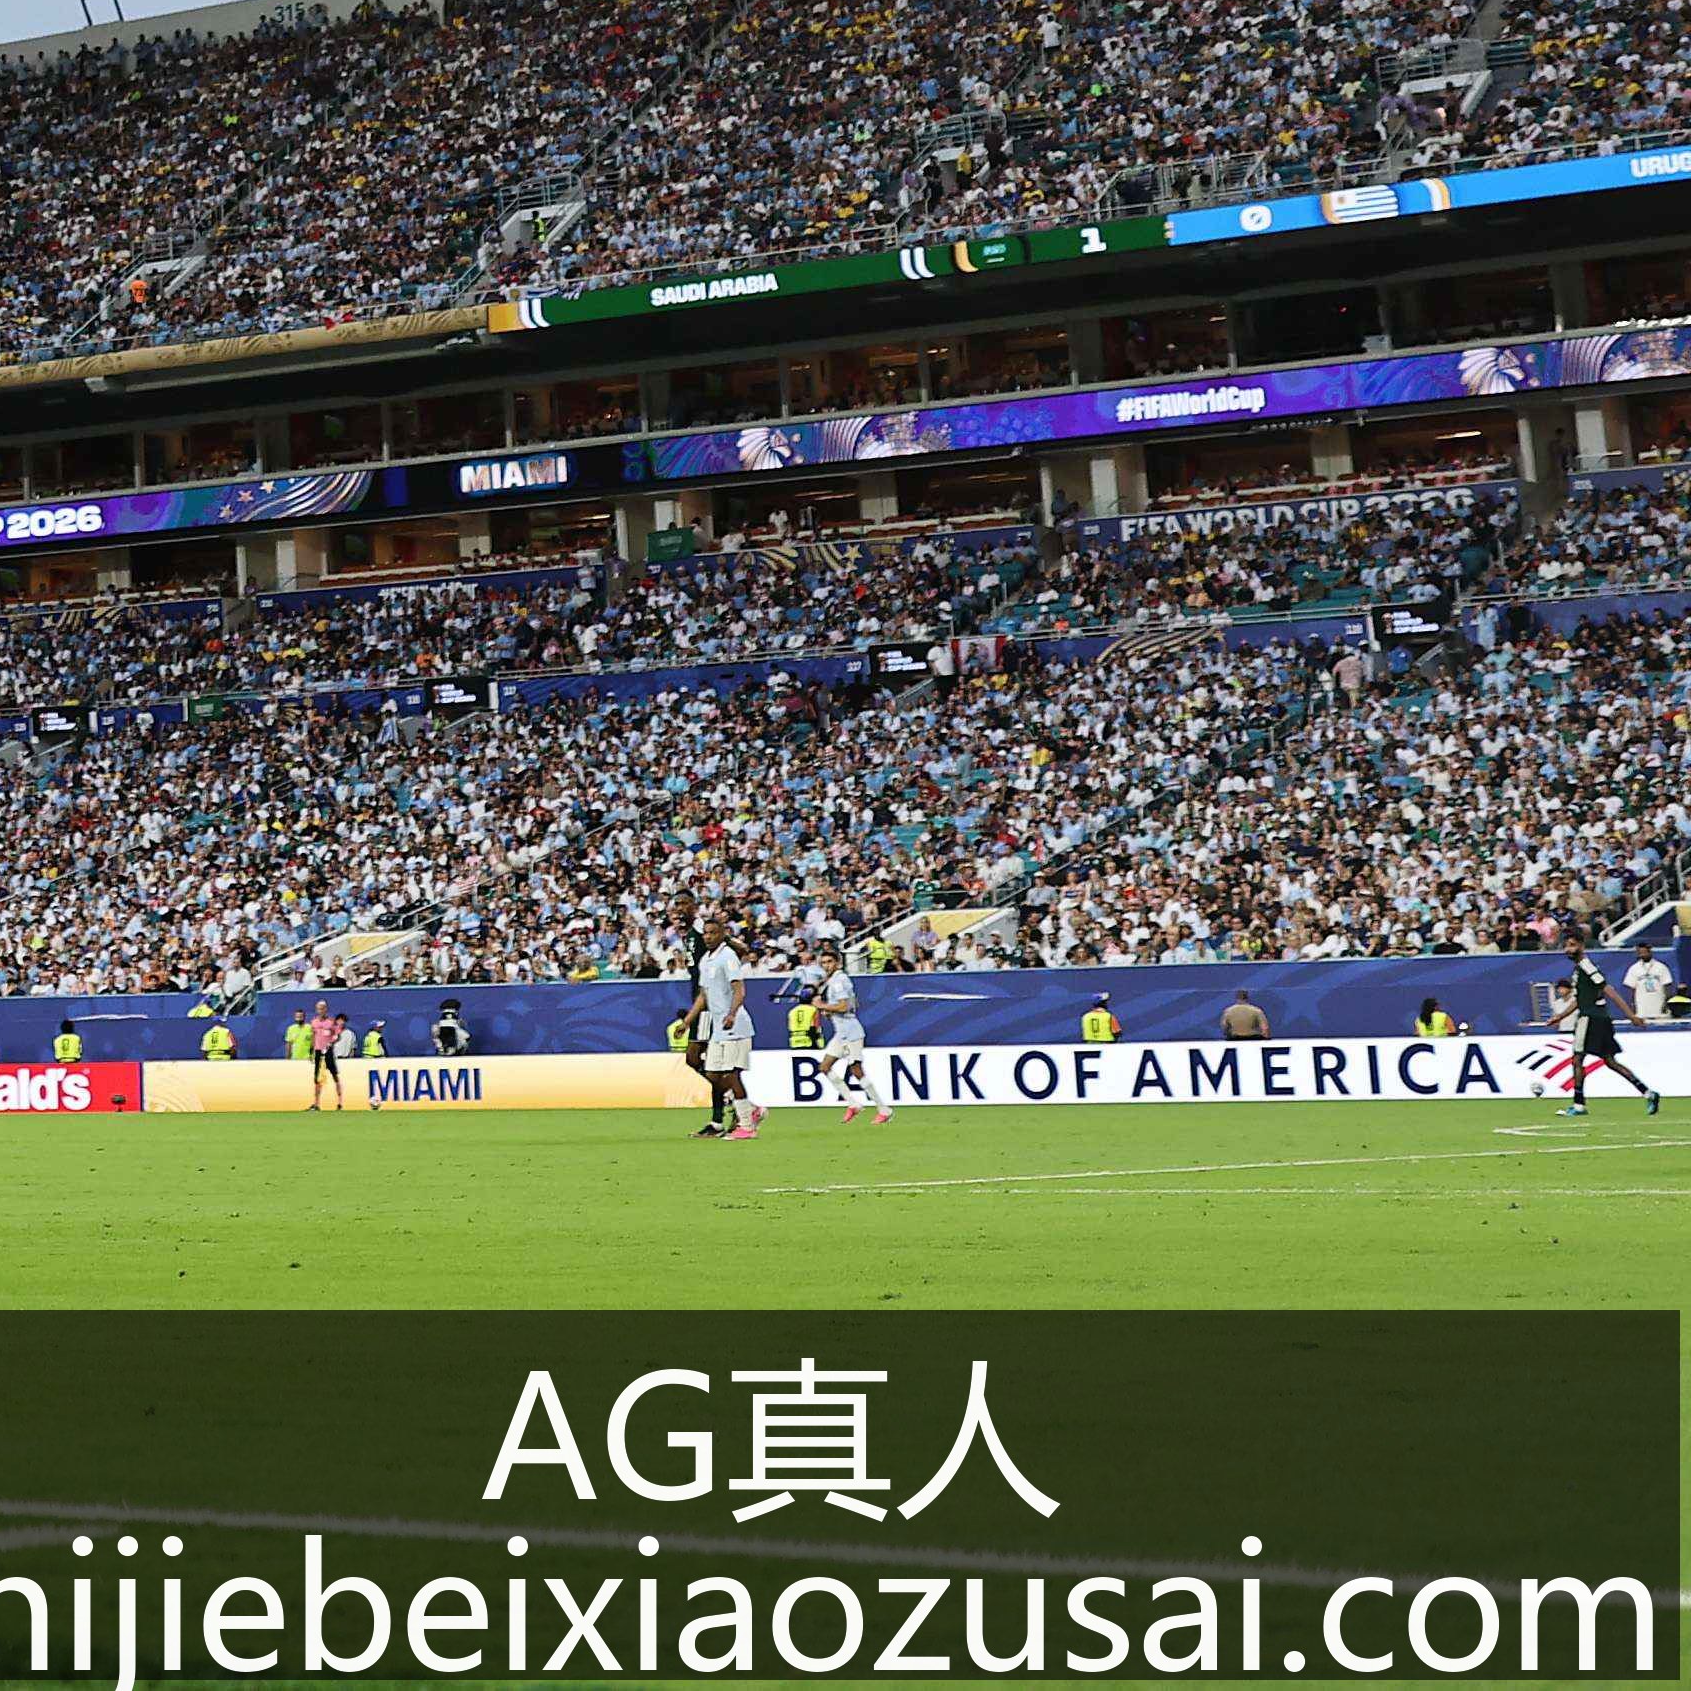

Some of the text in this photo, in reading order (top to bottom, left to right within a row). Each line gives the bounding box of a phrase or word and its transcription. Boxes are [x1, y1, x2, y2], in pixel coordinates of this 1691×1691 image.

[1239, 204, 1273, 232] 0
[1080, 227, 1107, 254] 1
[650, 272, 779, 307] SAUDI ARABIA
[1115, 385, 1266, 423] #FIFAWorldCup
[459, 455, 568, 493] MIAMI
[5, 505, 103, 540] 2026
[367, 1068, 481, 1102] MIAMI
[1013, 1050, 1103, 1100] OF
[1131, 1042, 1502, 1098] AMERICA
